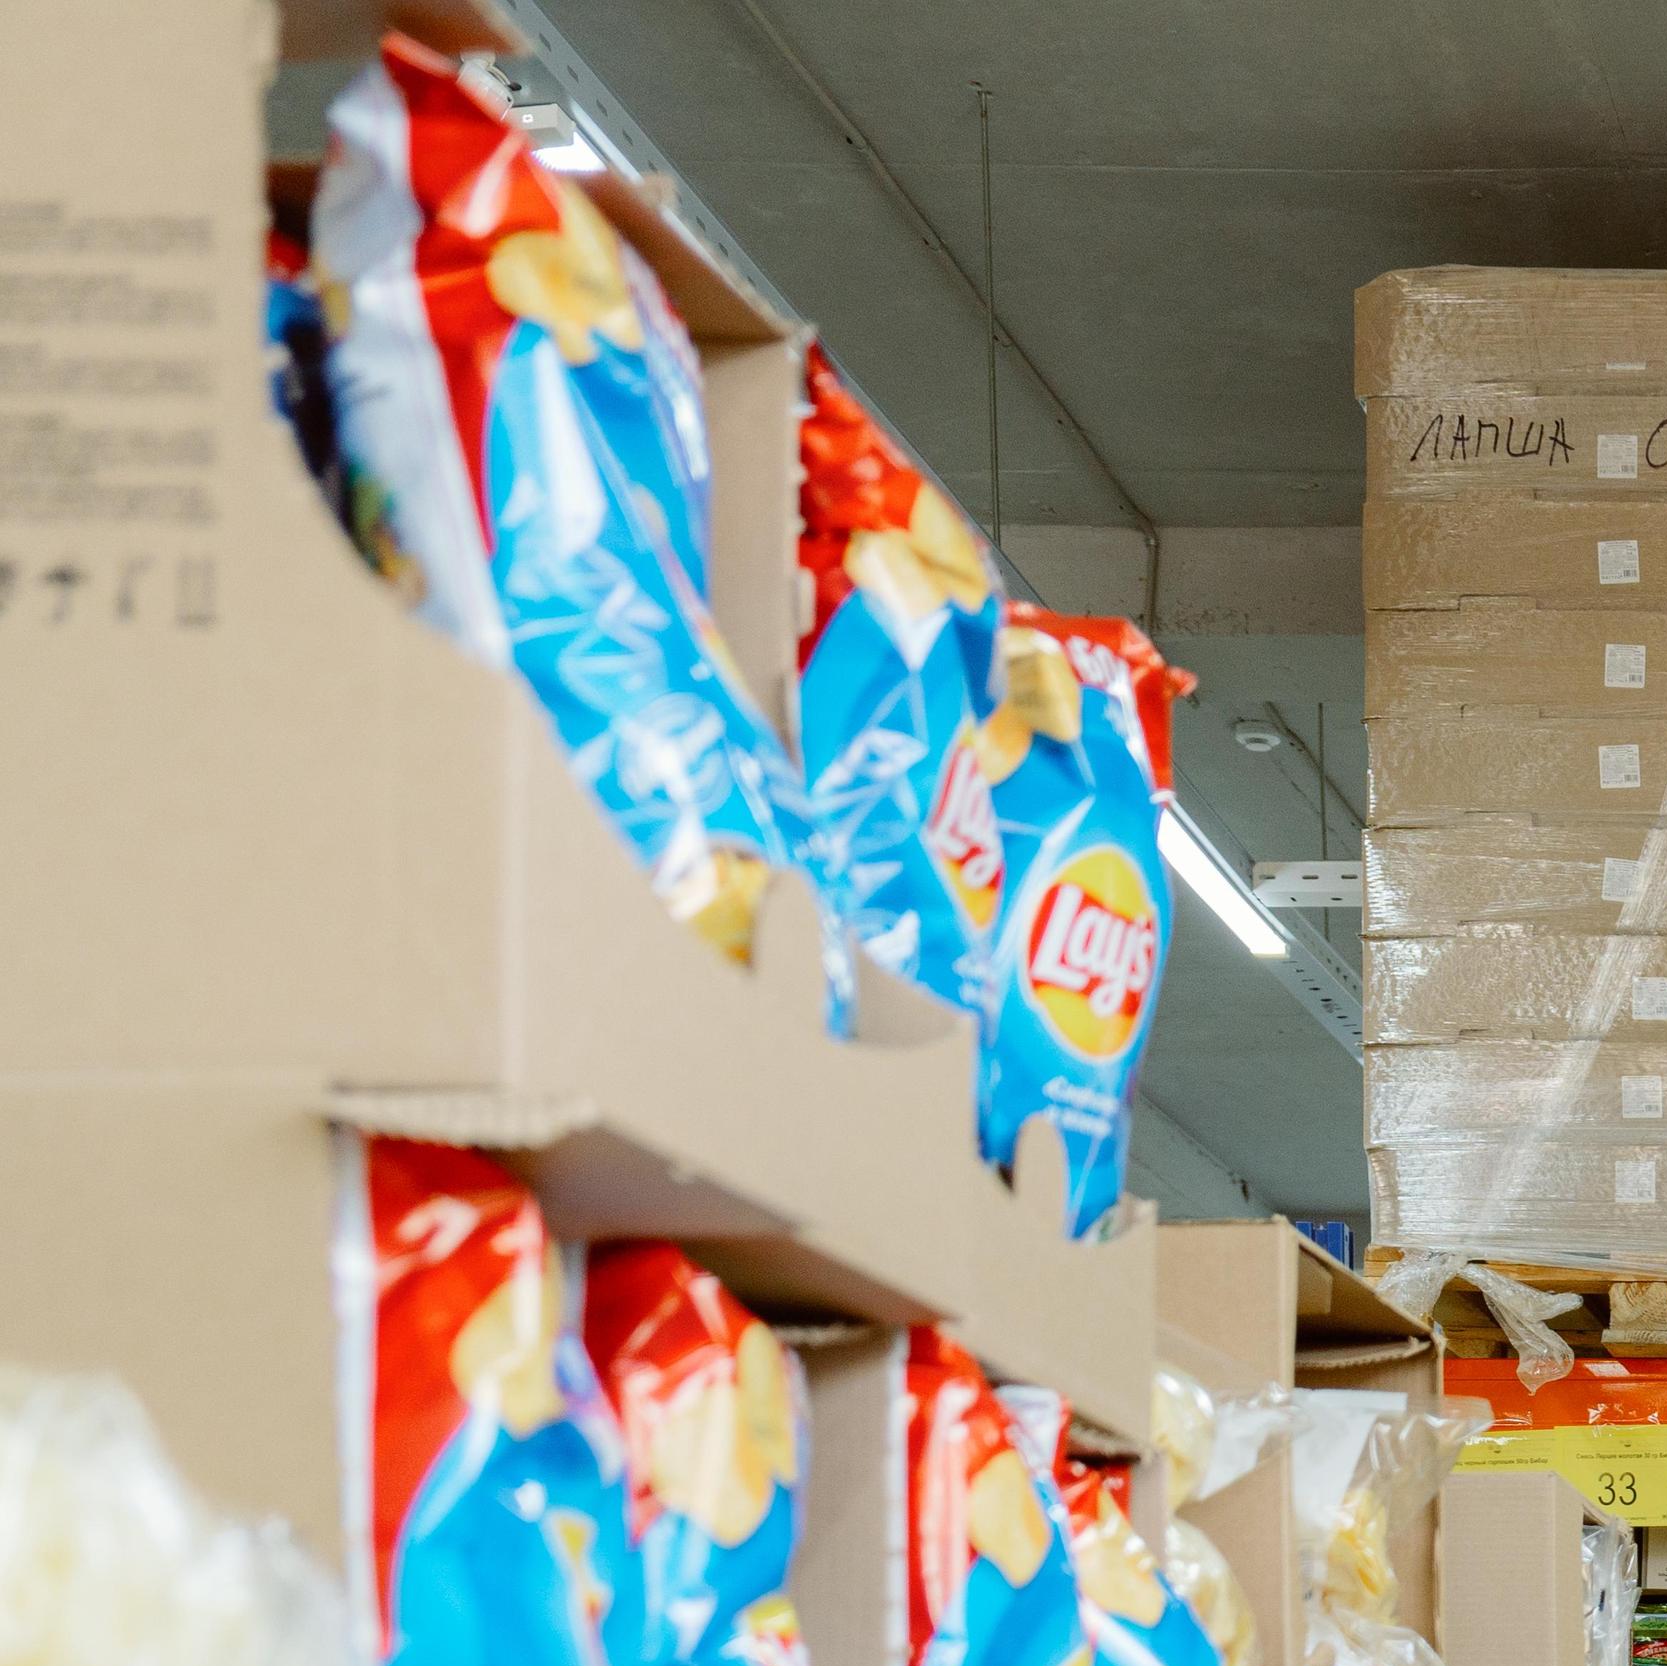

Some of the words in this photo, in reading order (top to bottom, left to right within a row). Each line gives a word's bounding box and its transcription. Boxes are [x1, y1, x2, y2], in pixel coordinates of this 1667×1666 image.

[1410, 413, 1574, 466] ЛАПША
[1028, 882, 1156, 1017] Lay's
[1598, 1472, 1637, 1506] 33
